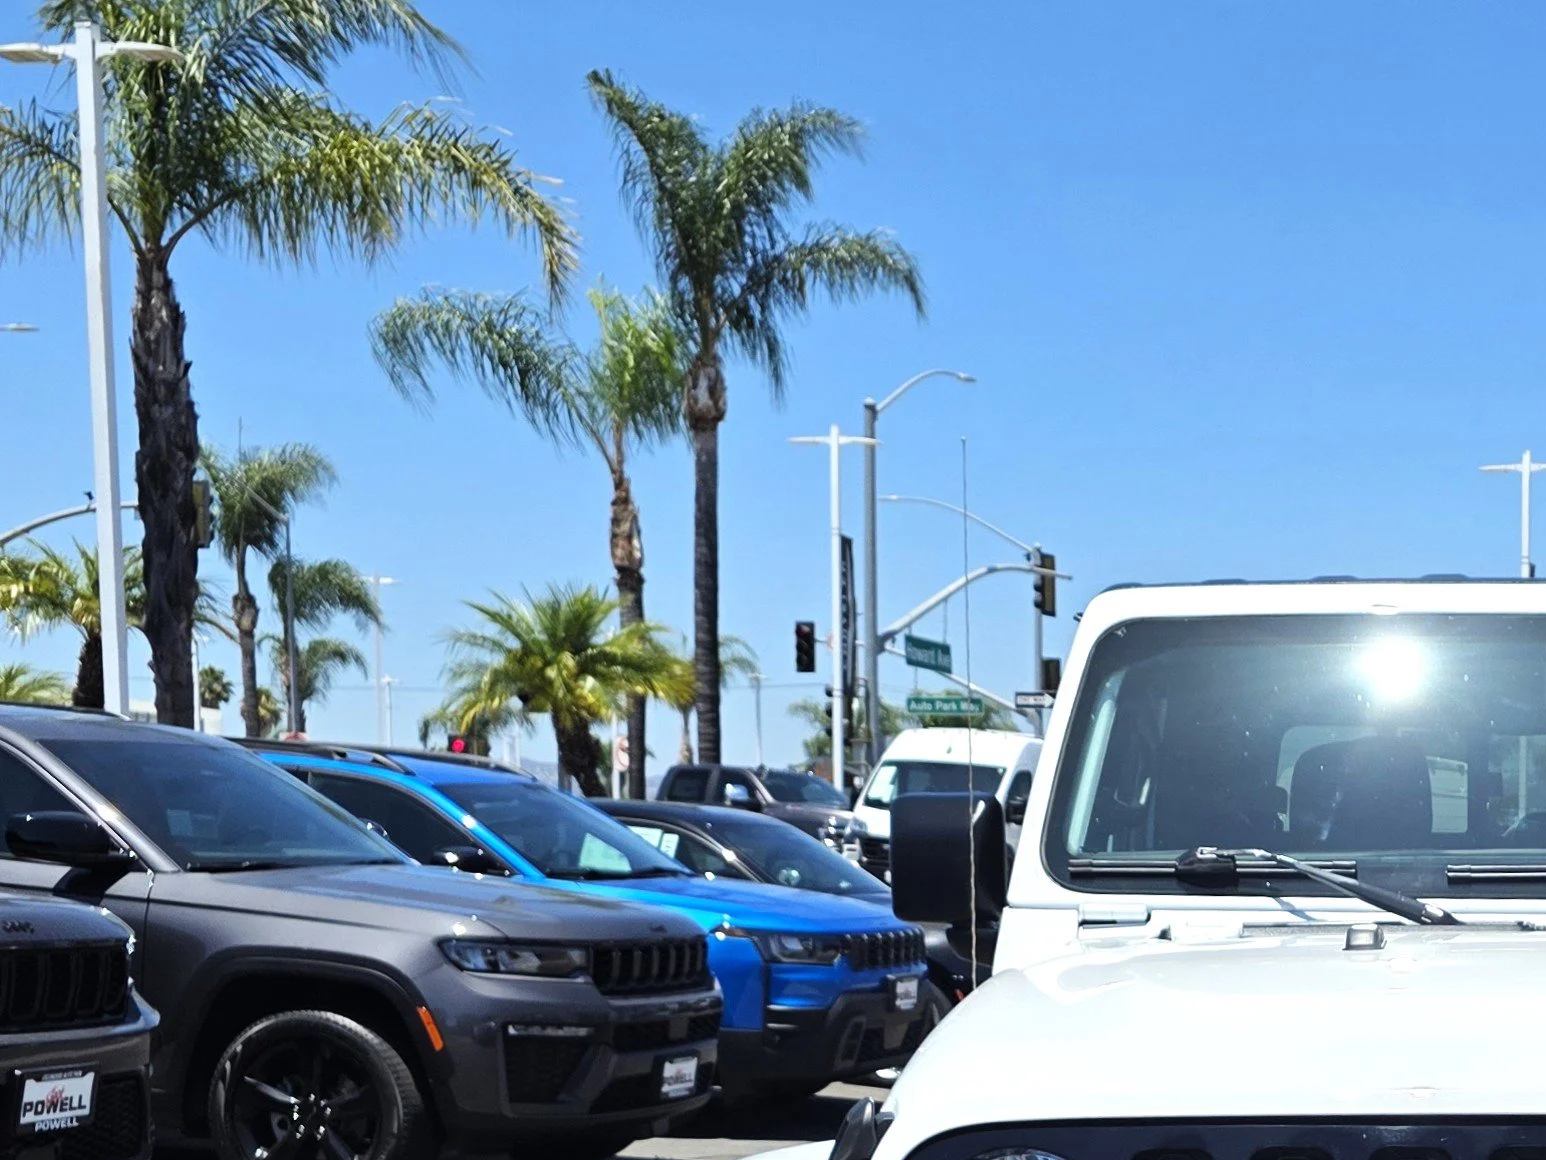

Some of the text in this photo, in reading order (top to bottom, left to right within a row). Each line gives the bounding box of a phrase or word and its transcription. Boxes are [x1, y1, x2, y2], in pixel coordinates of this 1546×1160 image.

[910, 700, 980, 713] Auto Park Way
[21, 1094, 87, 1118] POWELL
[34, 1116, 80, 1133] POWELL
